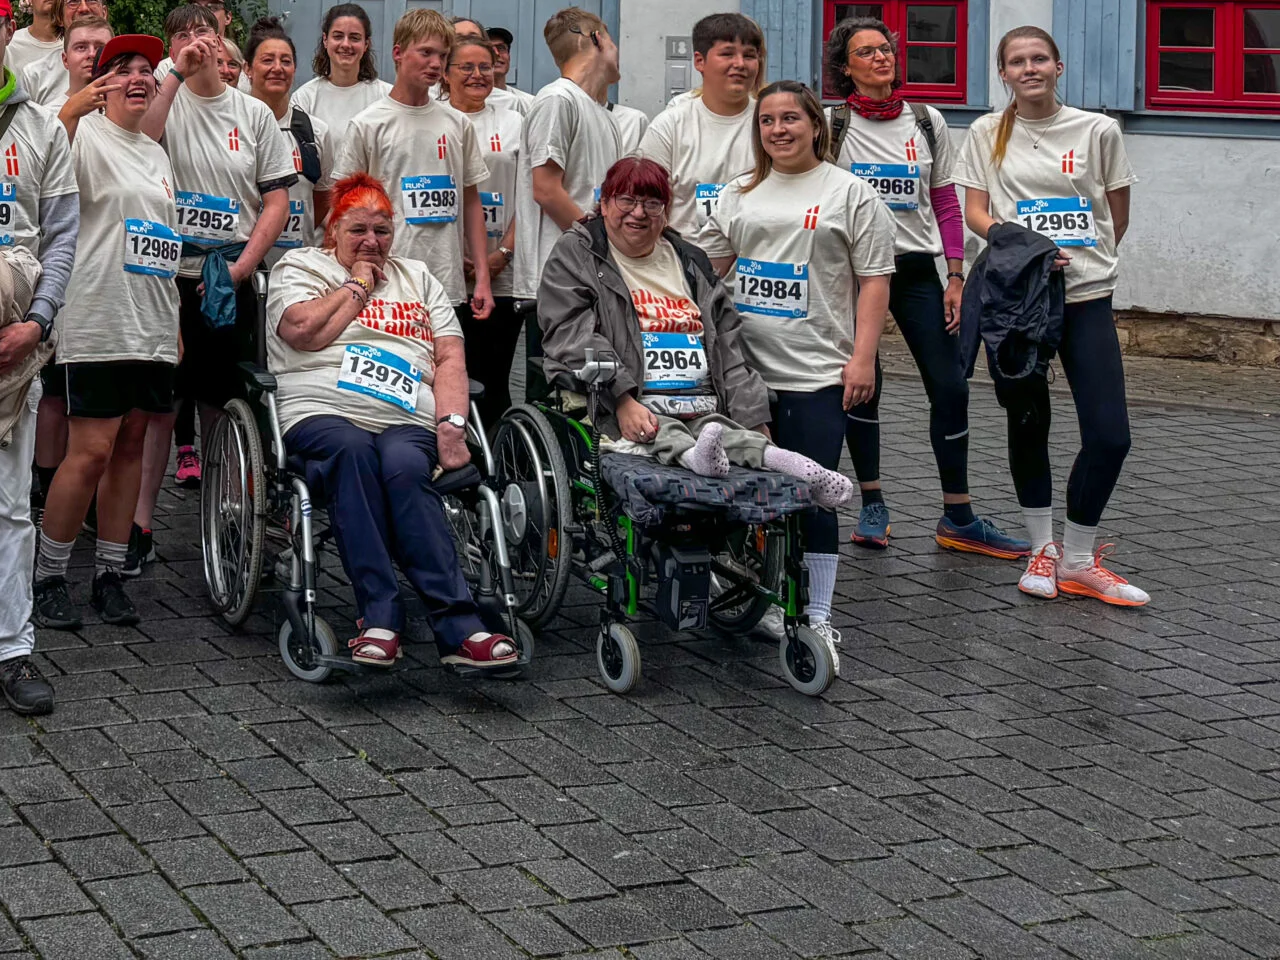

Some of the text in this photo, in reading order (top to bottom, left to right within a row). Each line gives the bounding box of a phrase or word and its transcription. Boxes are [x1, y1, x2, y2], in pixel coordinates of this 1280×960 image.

[672, 41, 687, 54] 18
[860, 177, 914, 195] 2968
[176, 197, 195, 205] RUN
[408, 190, 456, 208] 12983
[1020, 205, 1041, 213] RUN
[176, 207, 234, 232] 12952
[1023, 212, 1089, 231] 12963
[130, 225, 148, 234] RUN
[131, 235, 179, 262] 12986
[738, 264, 755, 274] RUN
[739, 275, 802, 301] 12984
[350, 346, 373, 358] RUN
[645, 350, 702, 371] 2964
[350, 356, 414, 395] 12975
